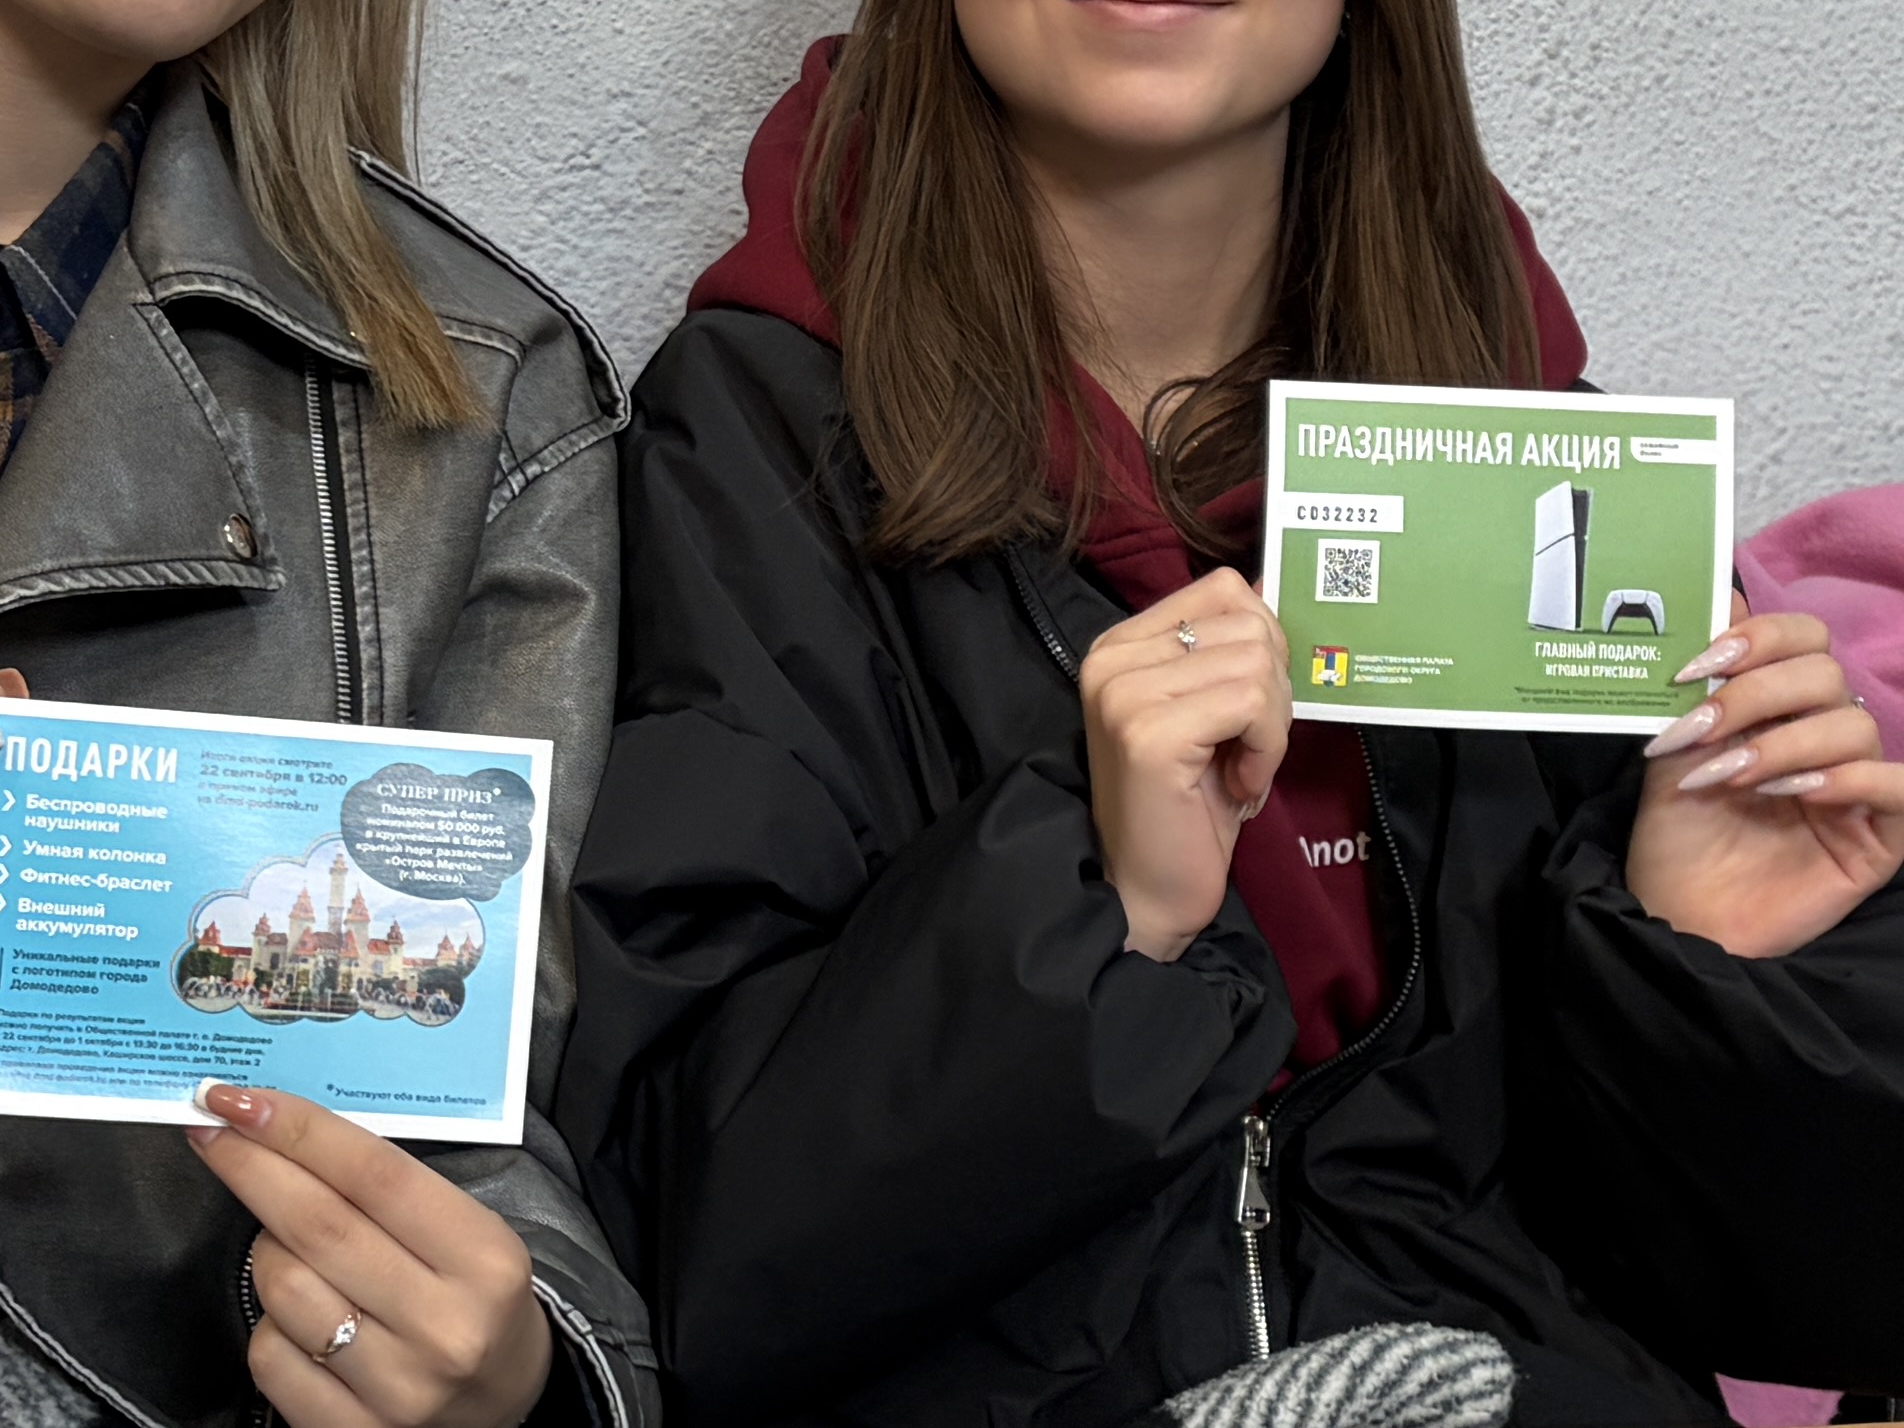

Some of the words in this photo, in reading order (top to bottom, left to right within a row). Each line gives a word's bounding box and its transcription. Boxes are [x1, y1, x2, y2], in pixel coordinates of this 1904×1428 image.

[1298, 424, 1513, 467] ПРАЗДНИЧНАЯ
[1521, 434, 1621, 474] АКЦИЯ
[1297, 506, 1379, 524] C032232
[1535, 641, 1595, 660] ГЛАВНЫЙ
[1598, 643, 1661, 663] ПОДАРОК:
[1545, 663, 1590, 677] ИГРОВАЯ
[1592, 665, 1649, 679] ПРИСТАВКА
[4, 735, 178, 783] ПОДАРКИ
[200, 764, 219, 778] 22
[223, 766, 292, 785] сентября
[295, 773, 304, 783] в
[309, 771, 348, 786] 12:00
[377, 783, 439, 800] СУПЕР
[25, 793, 168, 820] Беспроводные
[25, 816, 120, 834] наушники
[22, 840, 83, 861] Умная
[88, 847, 167, 865] колонка
[19, 868, 172, 893] Фитнес-браслет
[17, 897, 106, 918] Внешний
[15, 916, 139, 942] аккумулятор
[13, 948, 99, 967] Уникальные
[102, 957, 160, 970] подарки
[12, 966, 19, 974] с
[22, 966, 96, 984] логотипом
[99, 972, 148, 985] города
[9, 978, 99, 996] Домодедово
